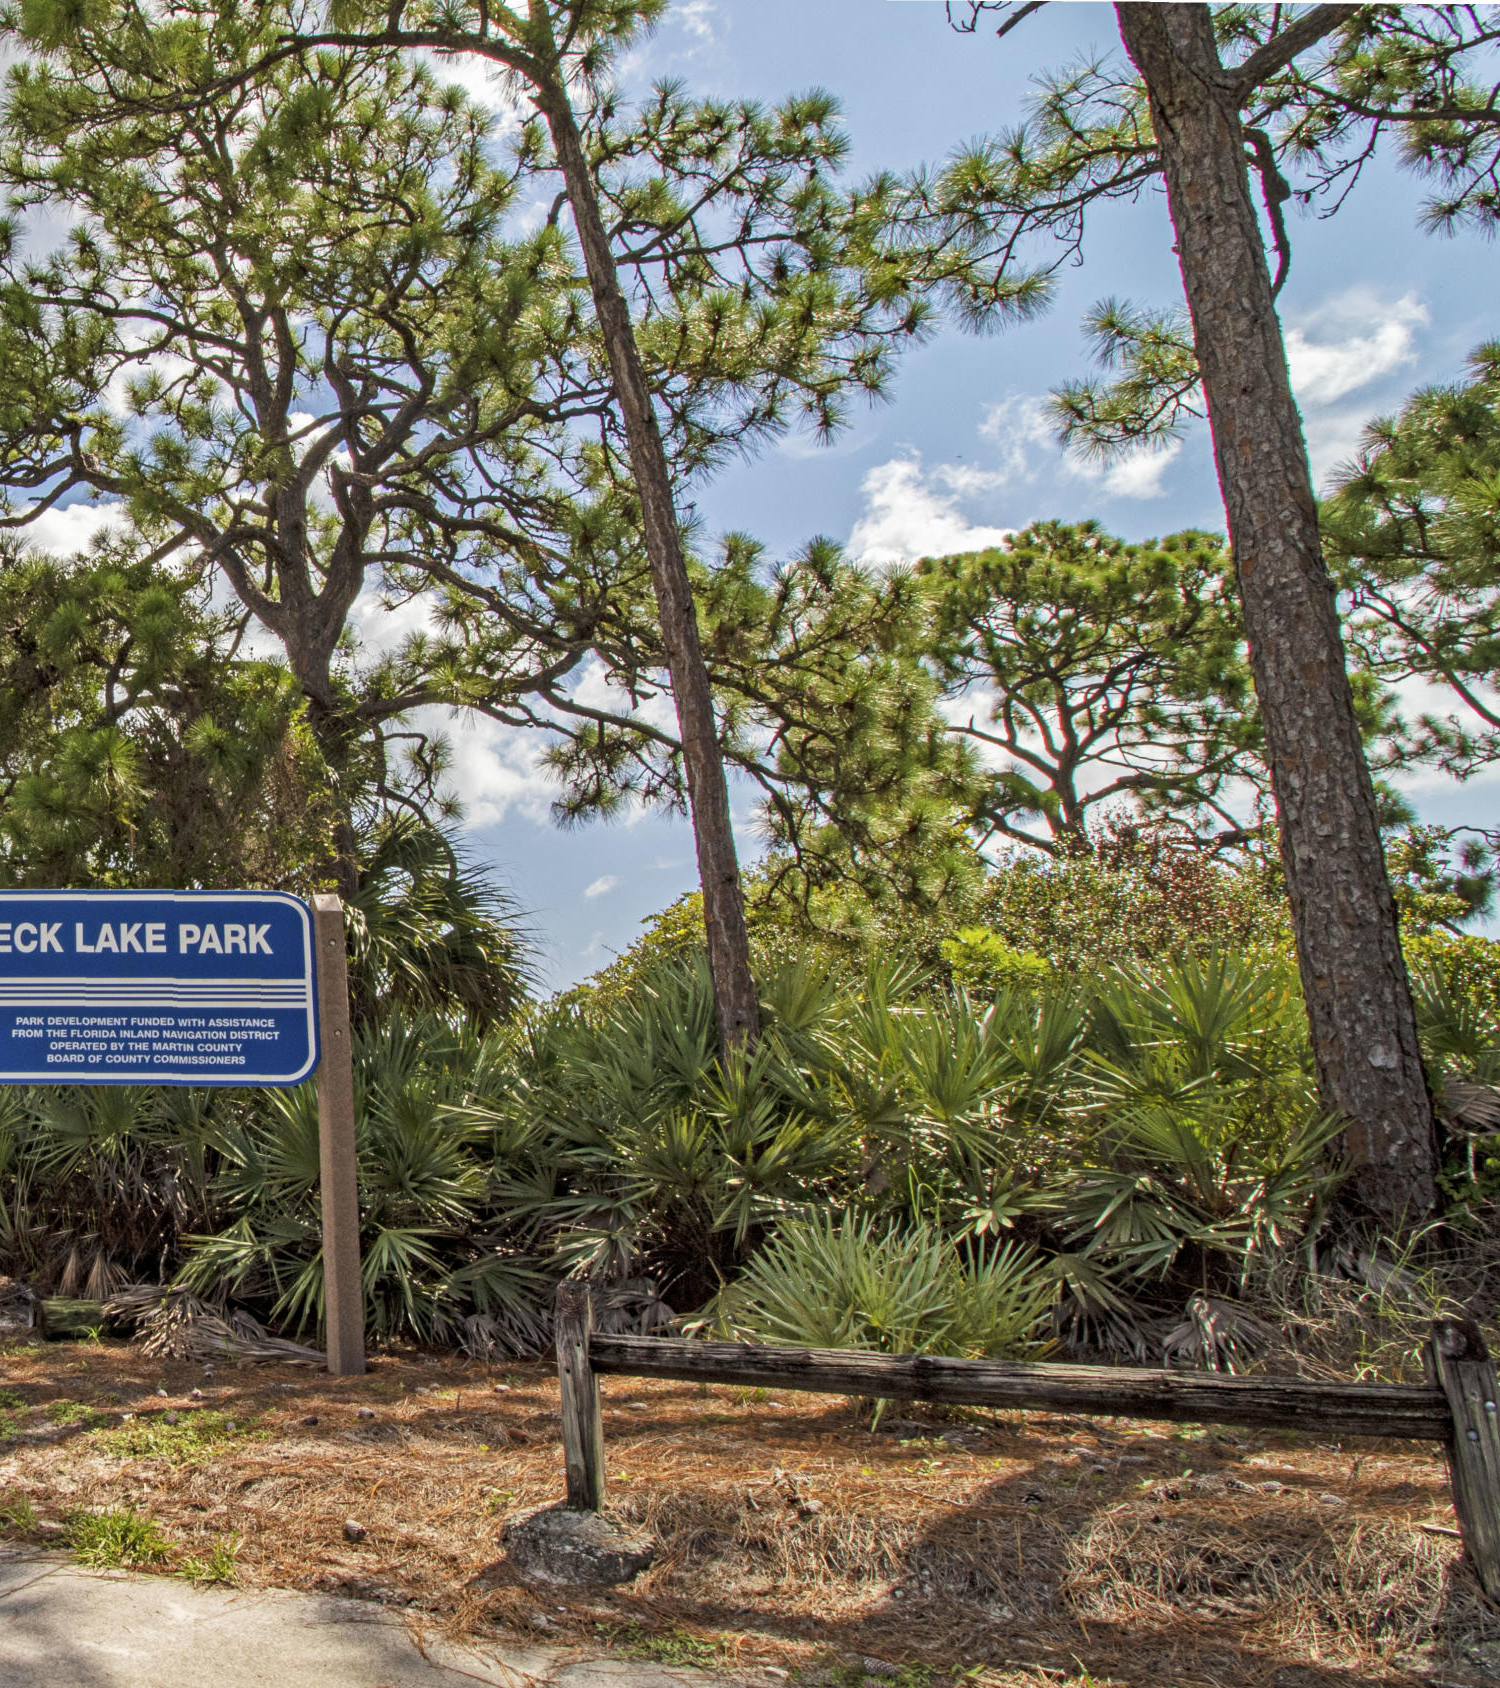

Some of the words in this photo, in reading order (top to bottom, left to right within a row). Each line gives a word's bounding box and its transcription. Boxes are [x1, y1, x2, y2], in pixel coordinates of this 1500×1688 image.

[76, 923, 167, 953] LAKE
[179, 923, 274, 955] PARK
[16, 1016, 45, 1026] PARK
[47, 1016, 128, 1026] DEVELOPMENT
[130, 1017, 175, 1026] FUNDED
[177, 1018, 206, 1027] WITH
[208, 1018, 275, 1028] ASSISTANCE
[11, 1029, 43, 1038] FROM
[45, 1029, 68, 1038] THE
[70, 1029, 117, 1038] FLORIDA
[119, 1029, 160, 1039] INLAND
[162, 1030, 227, 1040] NAVIGATION
[229, 1030, 280, 1040] DISTRICT
[50, 1041, 108, 1051] OPERATED
[110, 1042, 125, 1051] BY
[127, 1042, 149, 1051] THE
[152, 1042, 194, 1052] MARTIN
[197, 1043, 242, 1052] COUNTY
[46, 1054, 85, 1063] BOARD
[87, 1054, 103, 1063] OF
[105, 1054, 151, 1064] COUNTY
[153, 1054, 246, 1065] COMMISSIONERS
